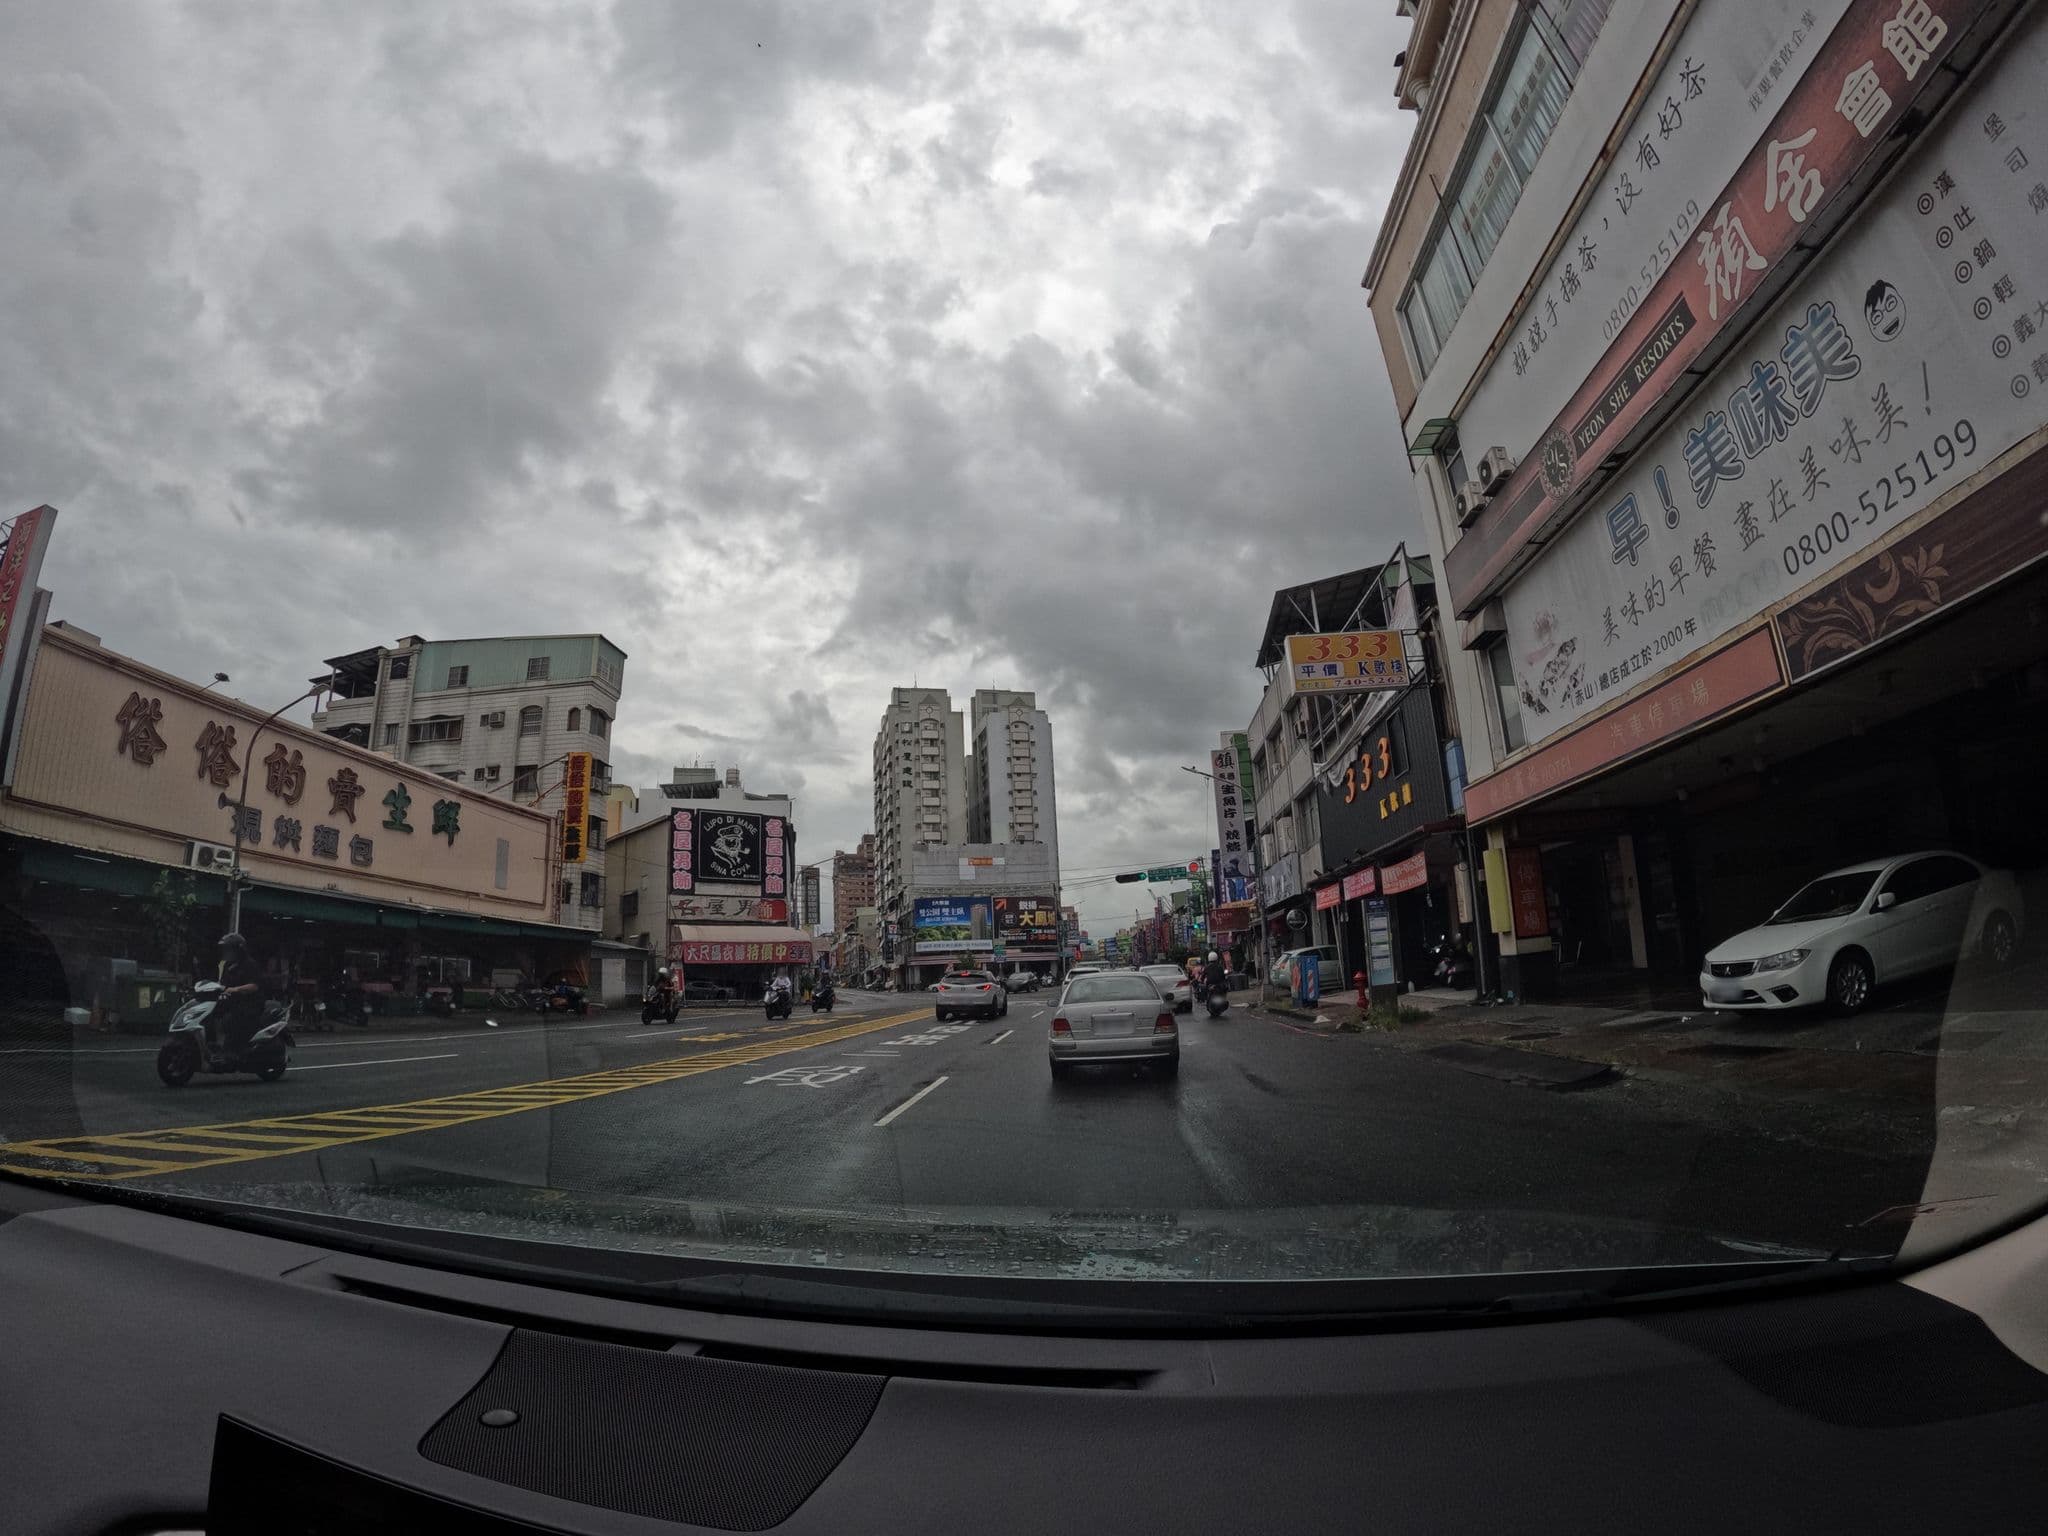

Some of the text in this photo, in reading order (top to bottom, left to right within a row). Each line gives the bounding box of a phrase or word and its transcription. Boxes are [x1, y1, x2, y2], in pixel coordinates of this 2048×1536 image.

[1601, 198, 1701, 342] 0800-525199
[1578, 314, 1686, 449] YEON SHE RESORTS
[1783, 418, 1979, 576] 0800-525199
[1601, 531, 1718, 647] 美味的早餐
[1301, 663, 1338, 678] 平價
[1307, 633, 1389, 662] 333
[1654, 627, 1684, 656] 2000
[116, 691, 461, 848] 俗俗的賣生鮮
[1344, 735, 1392, 804] 333
[703, 815, 759, 837] LUPO DI MARE
[710, 861, 727, 877] SINA
[730, 863, 752, 877] COVA
